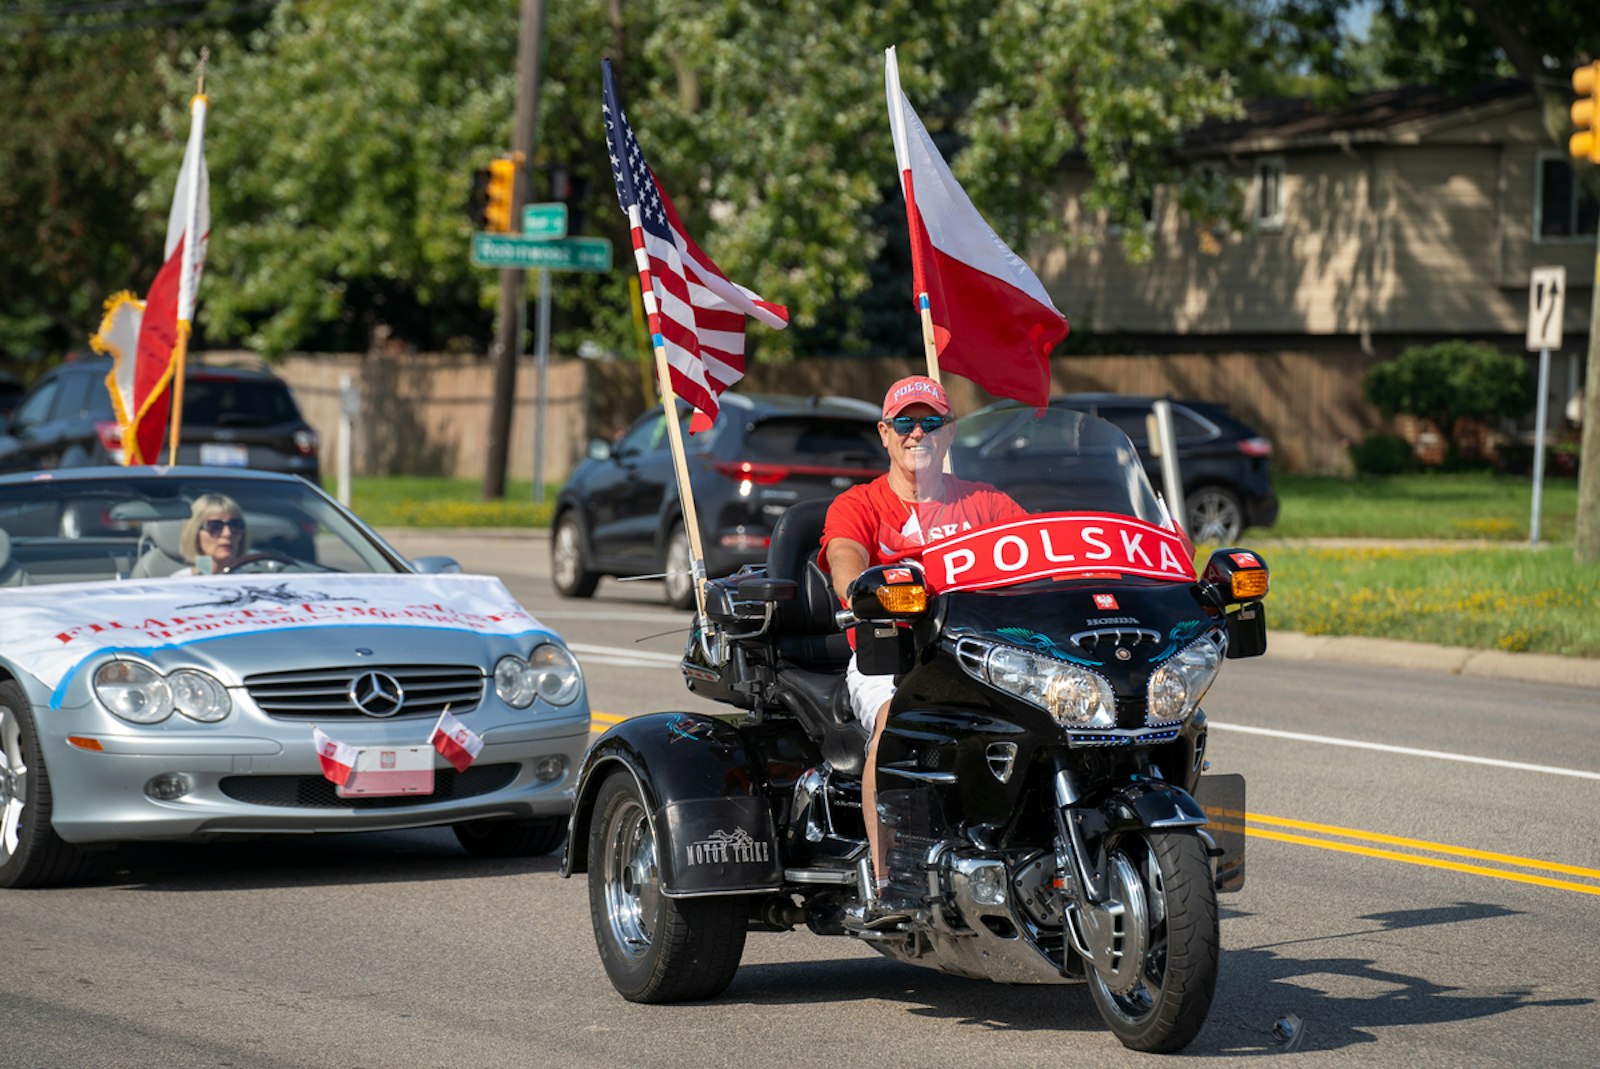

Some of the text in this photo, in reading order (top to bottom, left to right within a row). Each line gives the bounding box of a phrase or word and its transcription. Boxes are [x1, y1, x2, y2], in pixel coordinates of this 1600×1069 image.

[894, 381, 940, 401] POLSKA
[942, 526, 1187, 585] POLSKA
[1086, 617, 1140, 626] HONDA
[686, 841, 769, 866] MOTOR TRIKE
